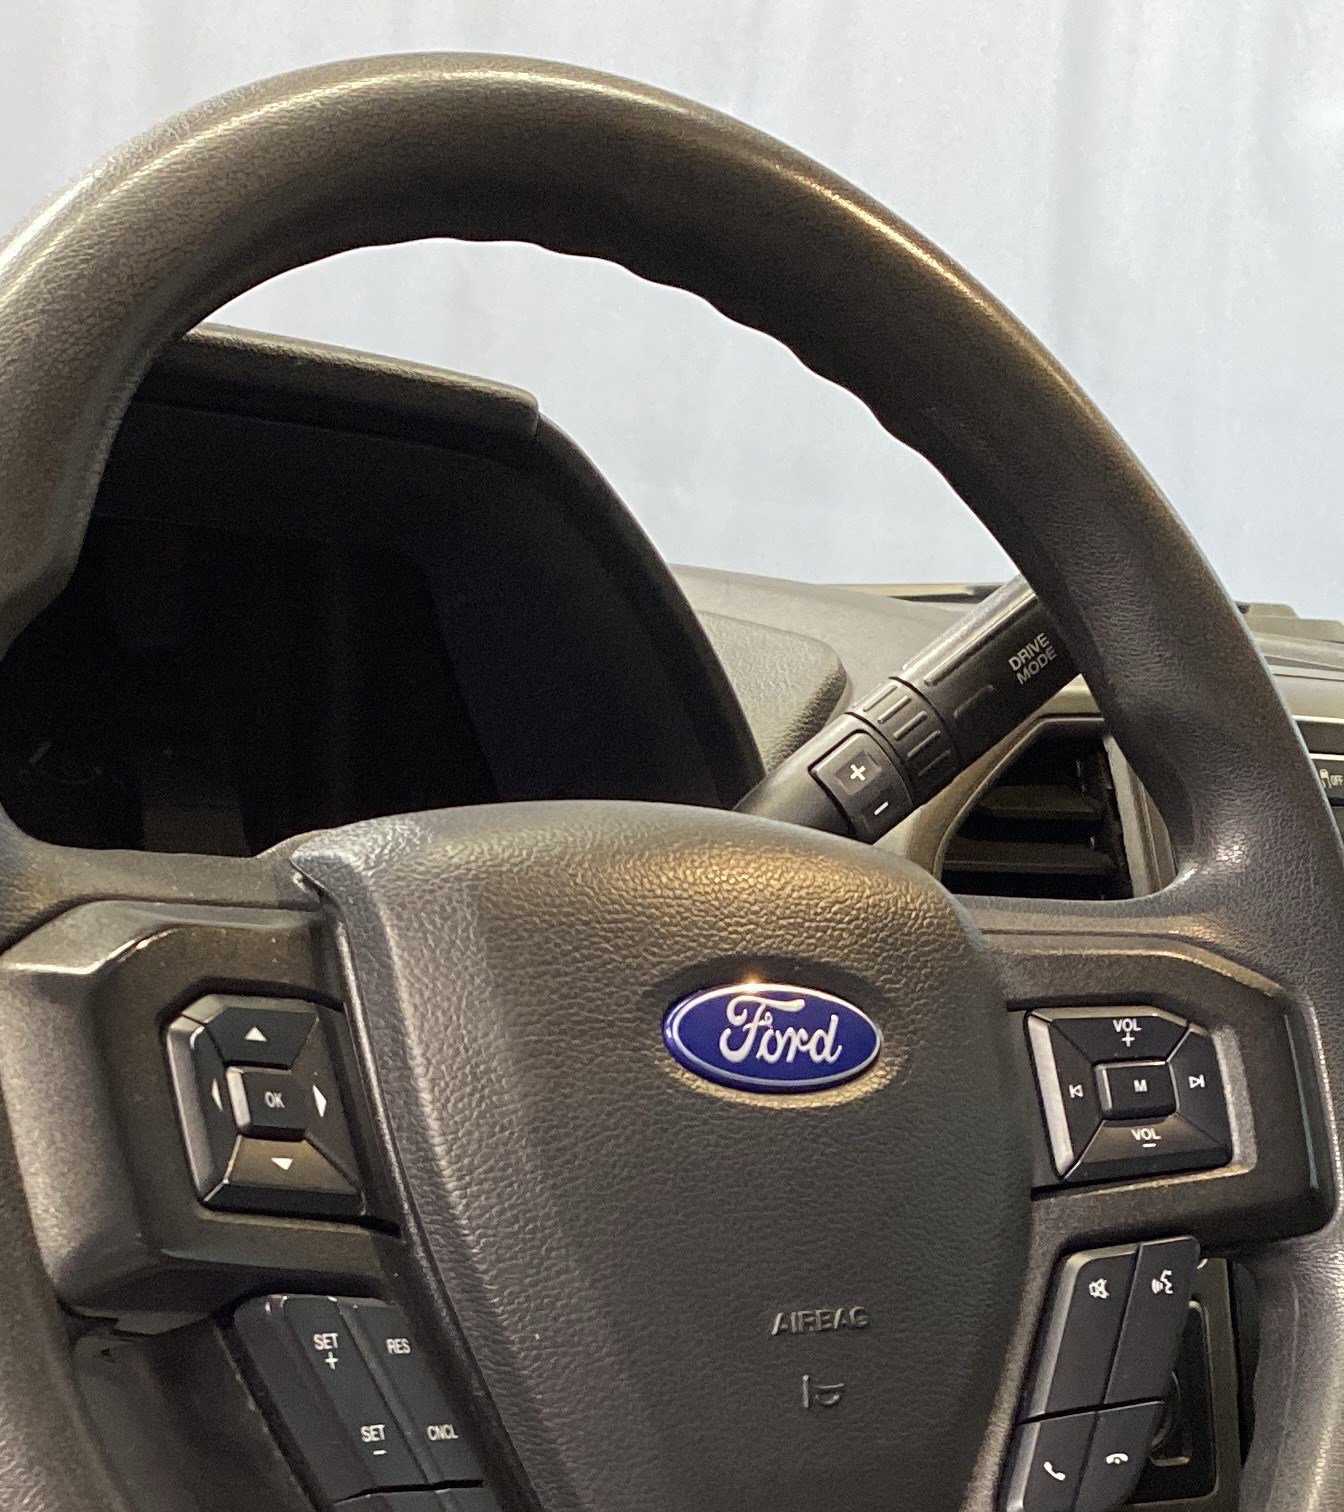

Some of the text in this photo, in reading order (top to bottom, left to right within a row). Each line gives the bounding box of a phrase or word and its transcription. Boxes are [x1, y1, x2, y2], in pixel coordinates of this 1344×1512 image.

[1008, 632, 1050, 671] DRIVE
[1016, 645, 1058, 685] MODE
[718, 995, 843, 1064] Ford
[1112, 1018, 1143, 1033] VOL
[1133, 1079, 1148, 1092] M
[264, 1091, 286, 1109] OK
[1131, 1128, 1162, 1141] VOL
[771, 1305, 870, 1336] AIRBAG
[312, 1332, 339, 1351] SET
[386, 1338, 411, 1355] RES
[360, 1424, 386, 1443] SET
